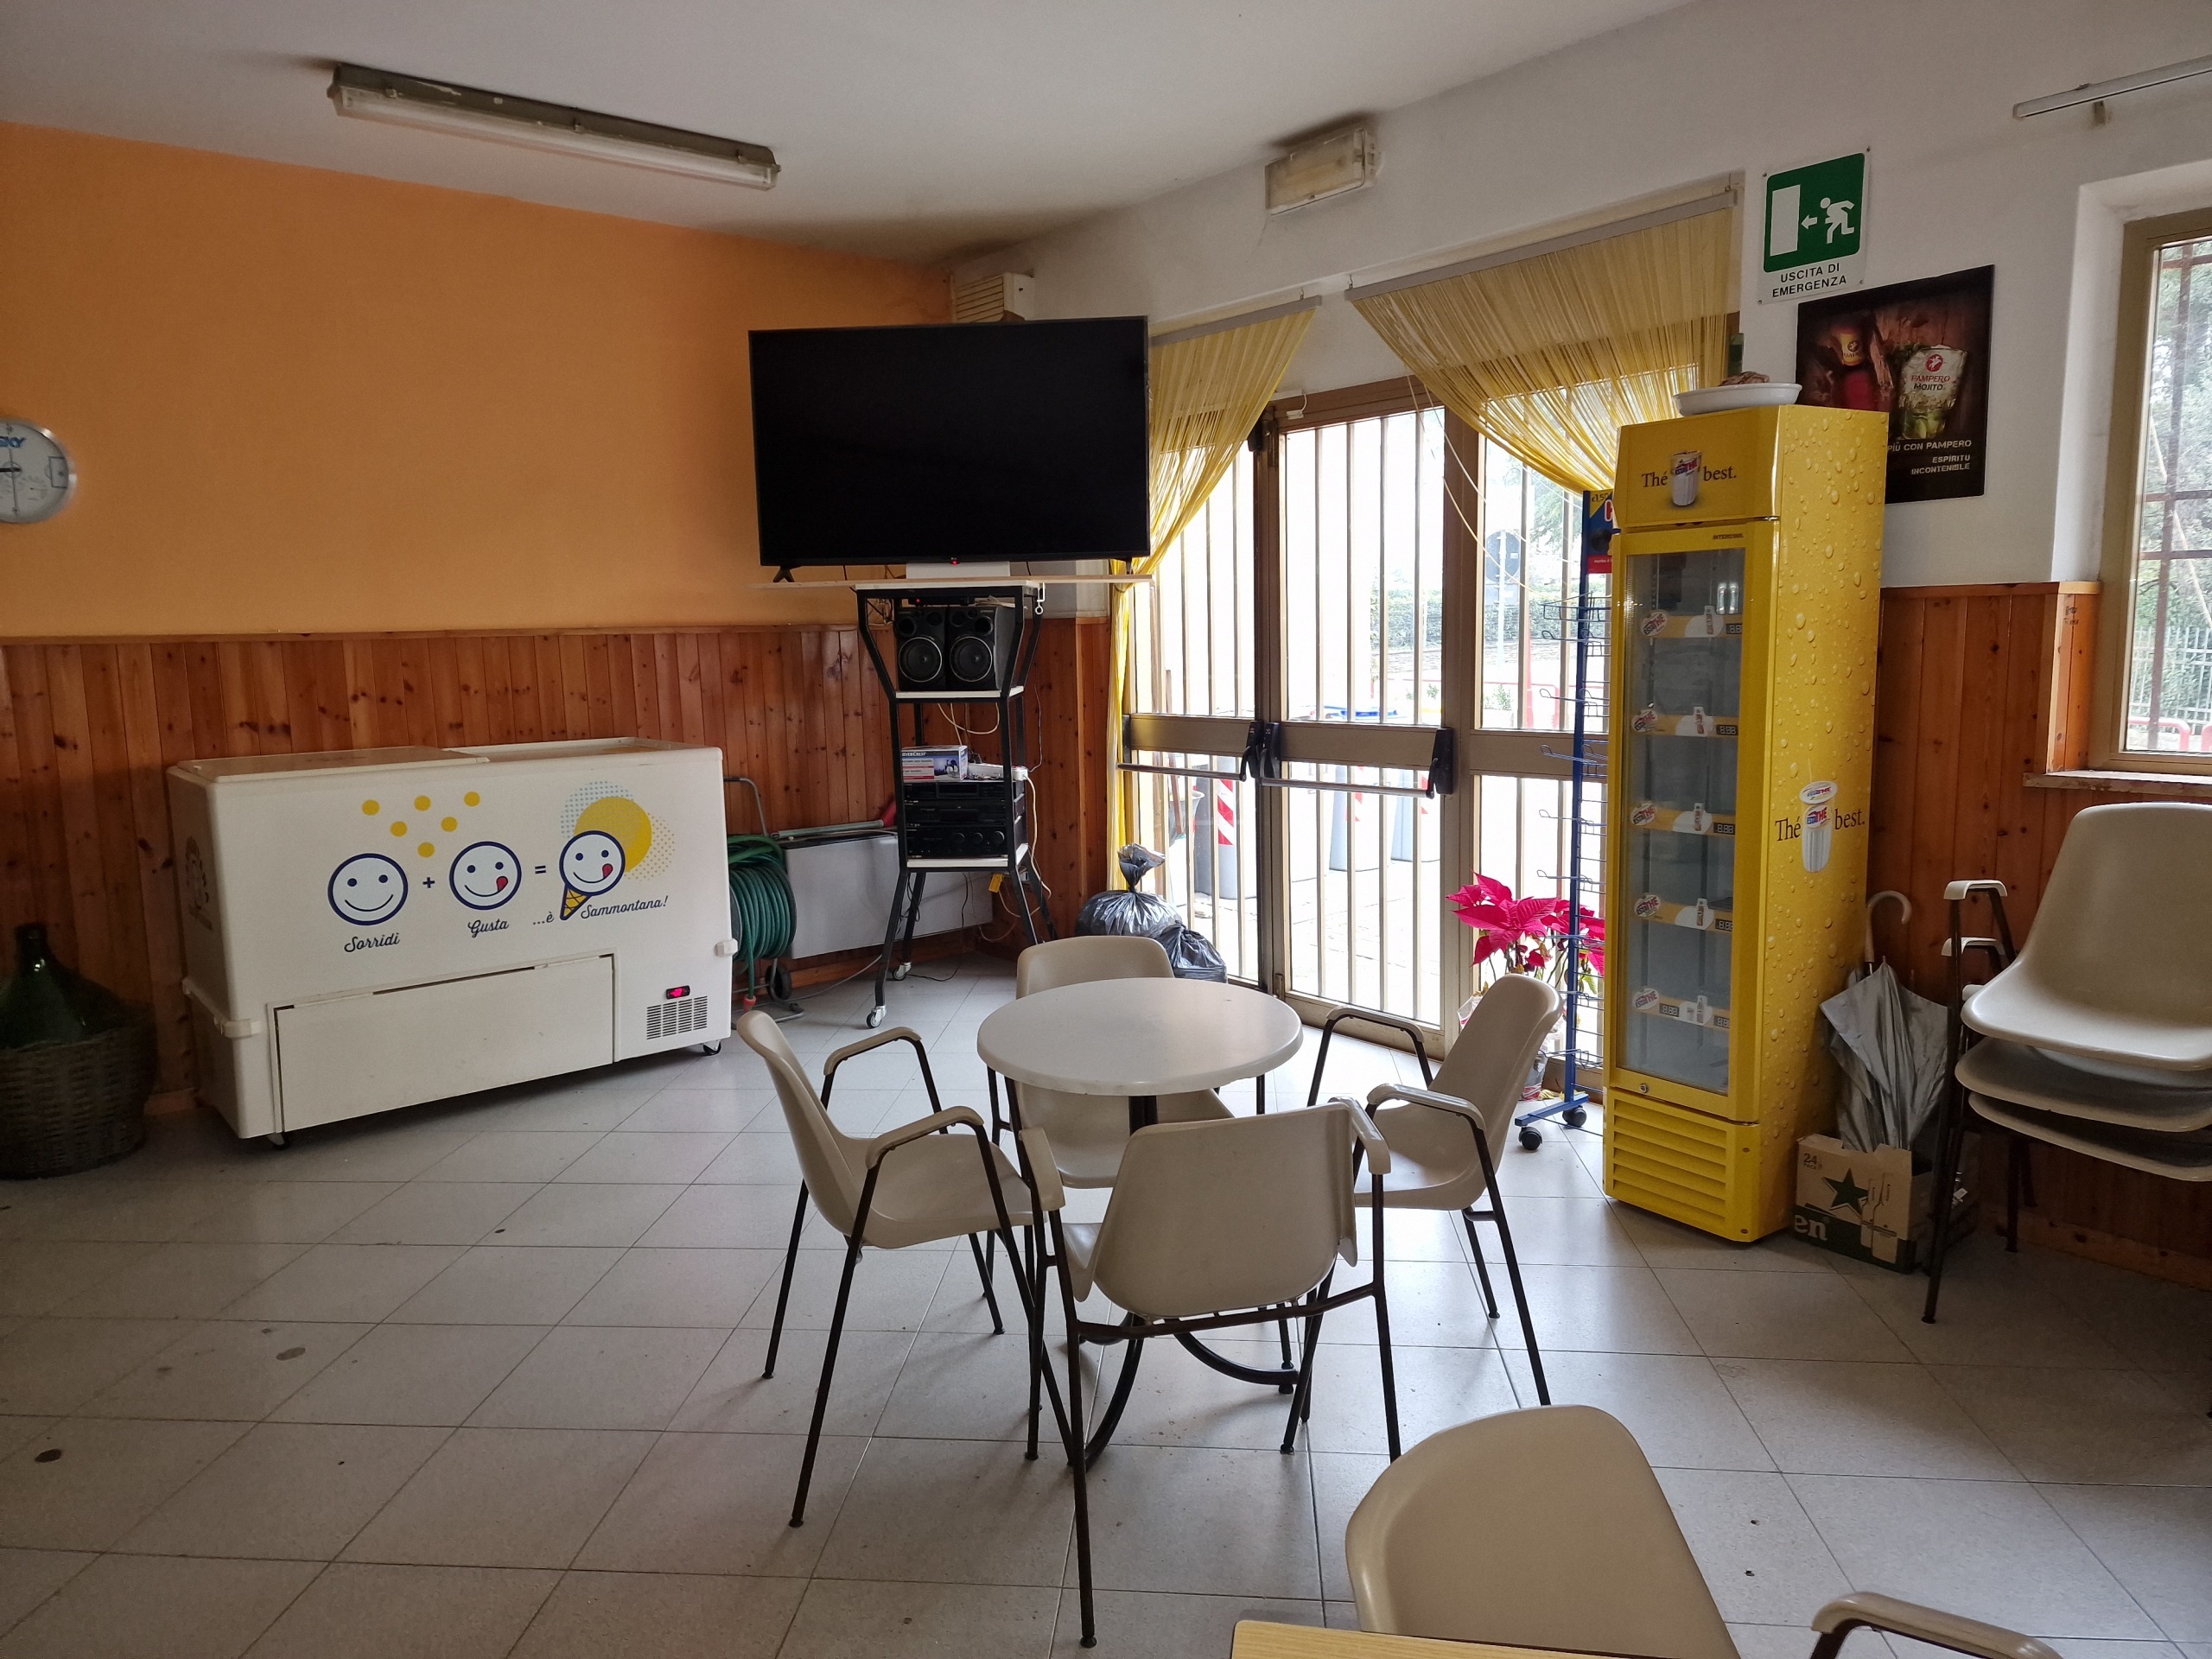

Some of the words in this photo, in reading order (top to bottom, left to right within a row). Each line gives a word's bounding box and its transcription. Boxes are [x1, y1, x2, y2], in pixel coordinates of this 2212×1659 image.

[1780, 264, 1824, 283] USCITA
[1827, 262, 1840, 274] DI
[1772, 275, 1847, 298] EMERGENZA
[1913, 383, 1943, 391] MOJITO
[1904, 442, 1923, 451] CON
[1926, 440, 1972, 450] PAMPERO
[1642, 471, 1668, 488] Thé
[1703, 465, 1738, 481] best.
[1911, 463, 1970, 475] INCONTENIBLE
[1775, 816, 1802, 842] Thé
[1834, 809, 1866, 830] best.
[580, 895, 669, 919] Sammontana!
[467, 918, 509, 938] Gusta
[344, 932, 400, 952] Sorridi
[1803, 1153, 1818, 1165] 24
